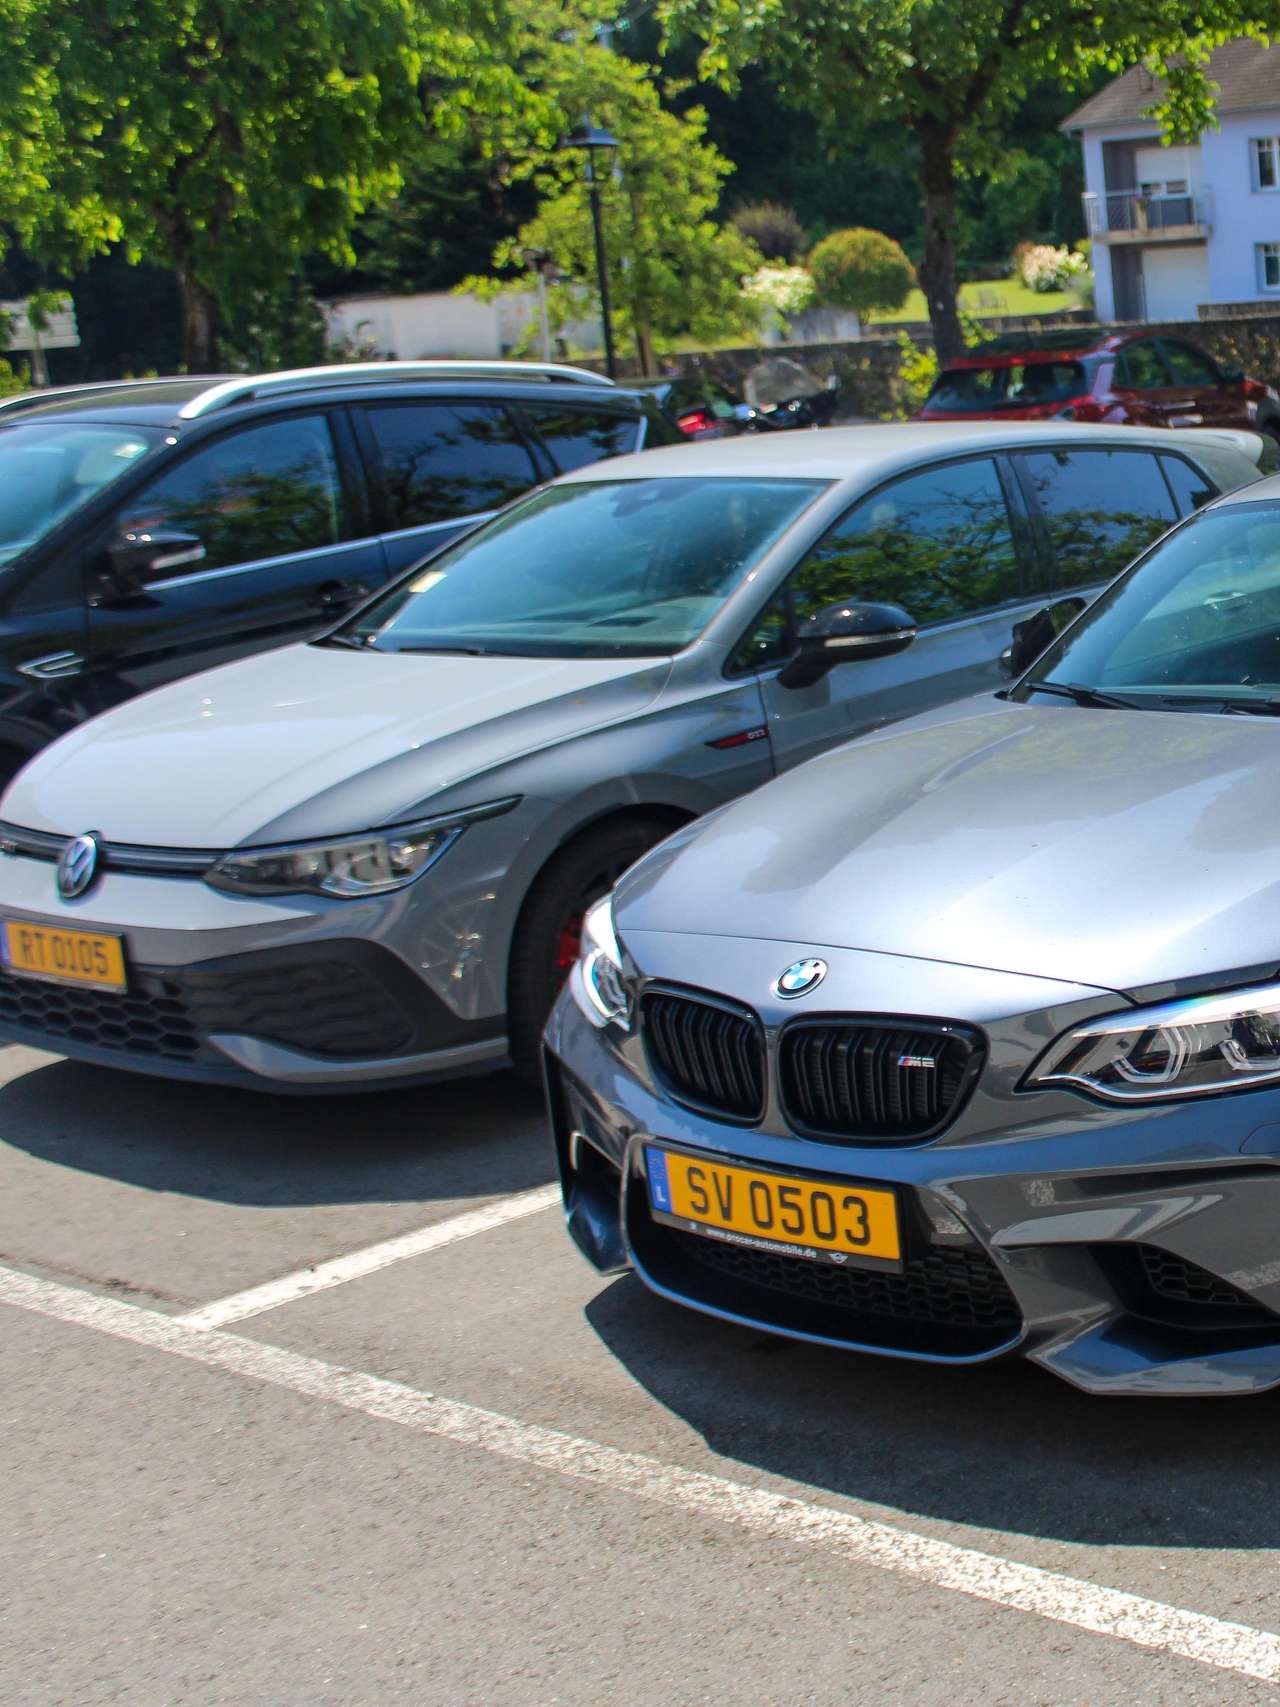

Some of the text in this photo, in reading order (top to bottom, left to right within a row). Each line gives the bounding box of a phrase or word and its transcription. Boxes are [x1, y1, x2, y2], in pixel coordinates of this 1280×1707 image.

[20, 930, 108, 975] RT 0105
[656, 1185, 667, 1203] L
[687, 1166, 871, 1246] SV 0503
[705, 1228, 818, 1259] www.procar-automobile.de
